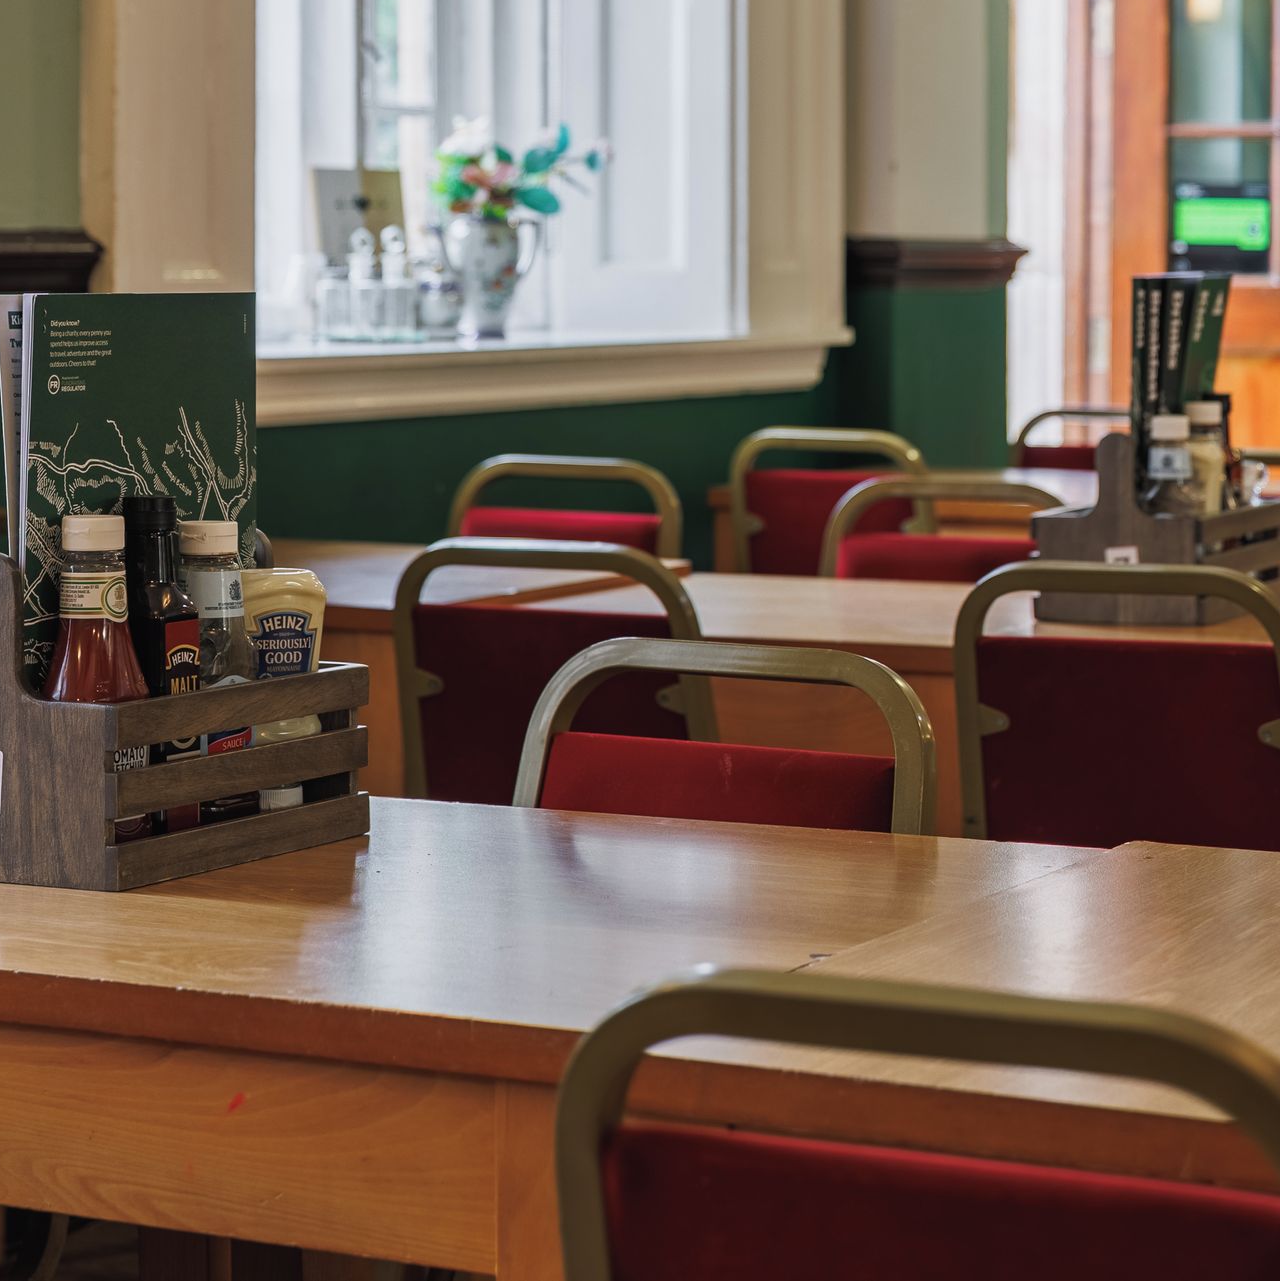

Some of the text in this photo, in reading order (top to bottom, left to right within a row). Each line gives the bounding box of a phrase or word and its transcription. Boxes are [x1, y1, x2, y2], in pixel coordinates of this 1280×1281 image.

[262, 615, 305, 632] HEINZ
[171, 651, 194, 666] HEINZ
[265, 650, 302, 664] GOOD
[170, 674, 198, 696] MALT
[222, 737, 243, 751] SAUCE
[113, 745, 145, 764] OMATO
[114, 759, 144, 772] ETCHUP
